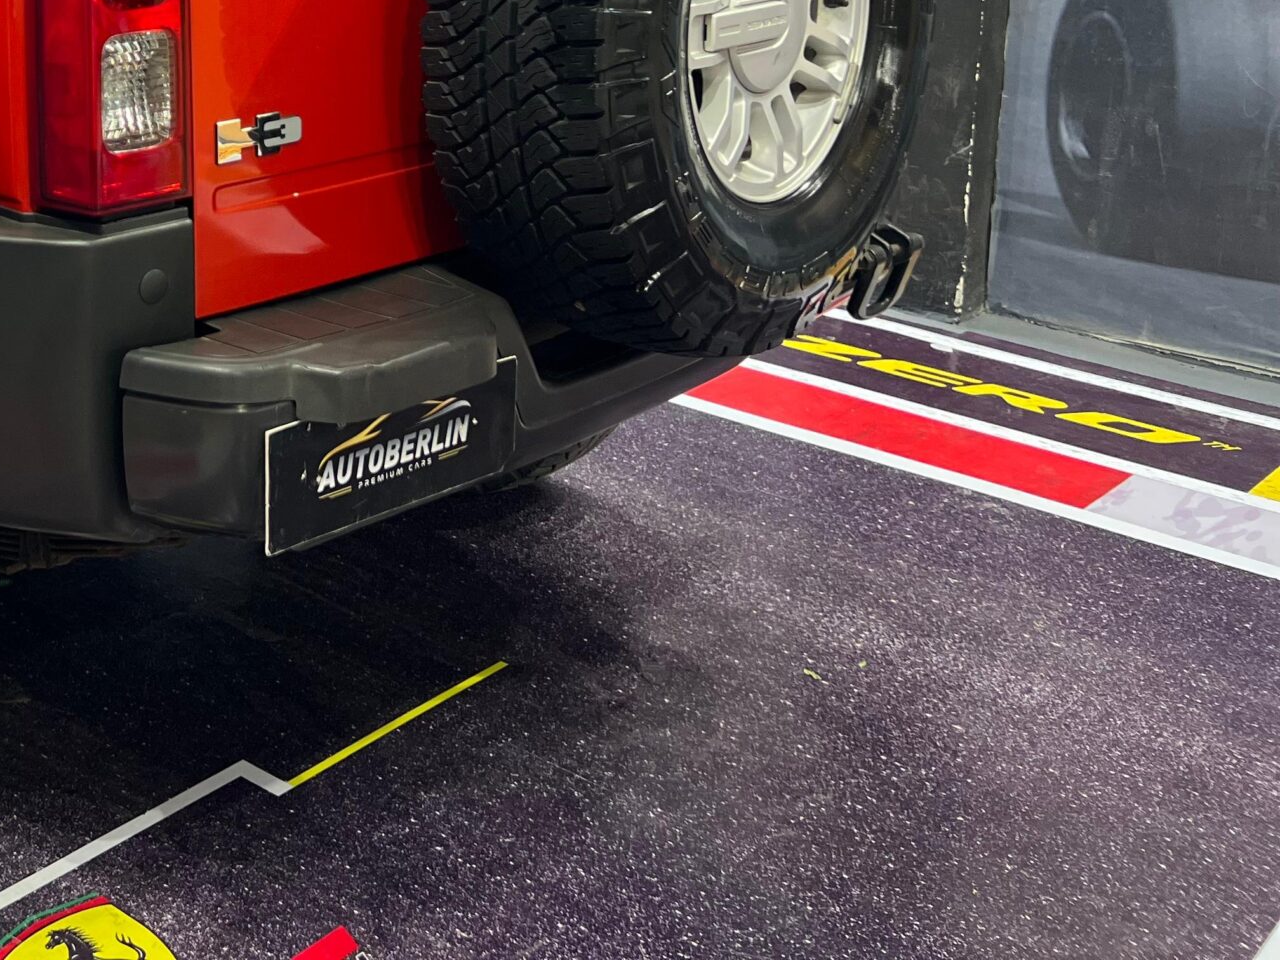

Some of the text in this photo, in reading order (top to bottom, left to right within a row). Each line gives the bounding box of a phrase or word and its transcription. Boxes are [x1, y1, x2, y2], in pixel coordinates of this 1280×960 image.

[781, 334, 1202, 444] ZERO
[317, 414, 470, 493] AUTOBERLIN
[358, 457, 433, 490] PREMIUM CARS
